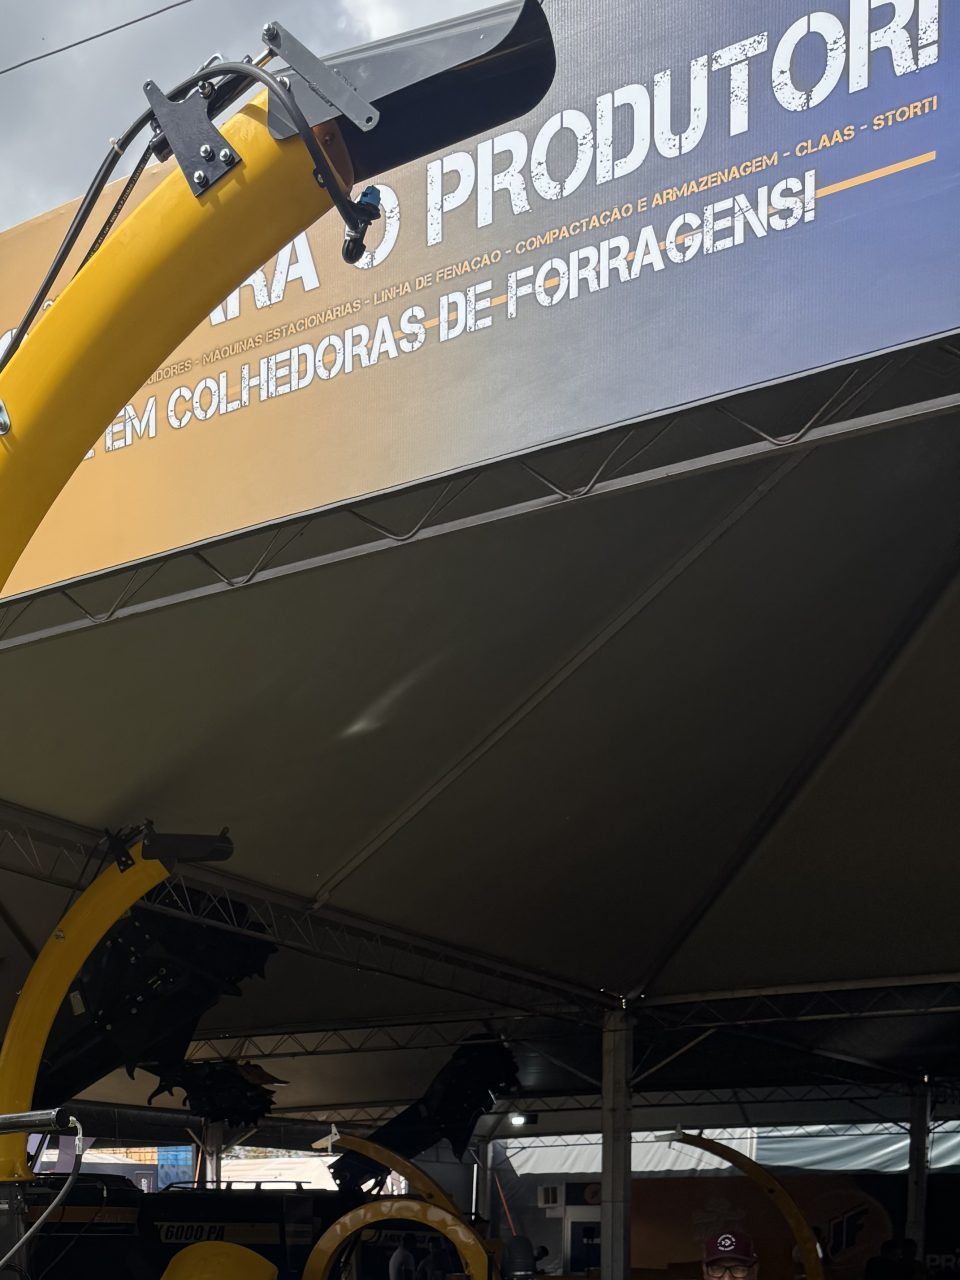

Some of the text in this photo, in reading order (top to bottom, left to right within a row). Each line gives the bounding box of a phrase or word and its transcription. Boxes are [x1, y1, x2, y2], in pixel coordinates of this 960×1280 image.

[208, 231, 320, 326] RA
[427, 0, 939, 247] PRODUTOR!
[373, 283, 413, 304] LINHA
[415, 274, 433, 289] DE
[436, 250, 502, 284] FENAÇÃO
[515, 203, 633, 255] COMPACTAÇÃO
[637, 197, 648, 214] E
[651, 151, 779, 209] ARMAZENAGEM
[795, 125, 856, 159] CLAAS
[872, 95, 938, 131] STORTI
[166, 304, 427, 430] COLHEDORAS
[439, 279, 493, 343] DE
[506, 168, 816, 320] FORRAGENS!
